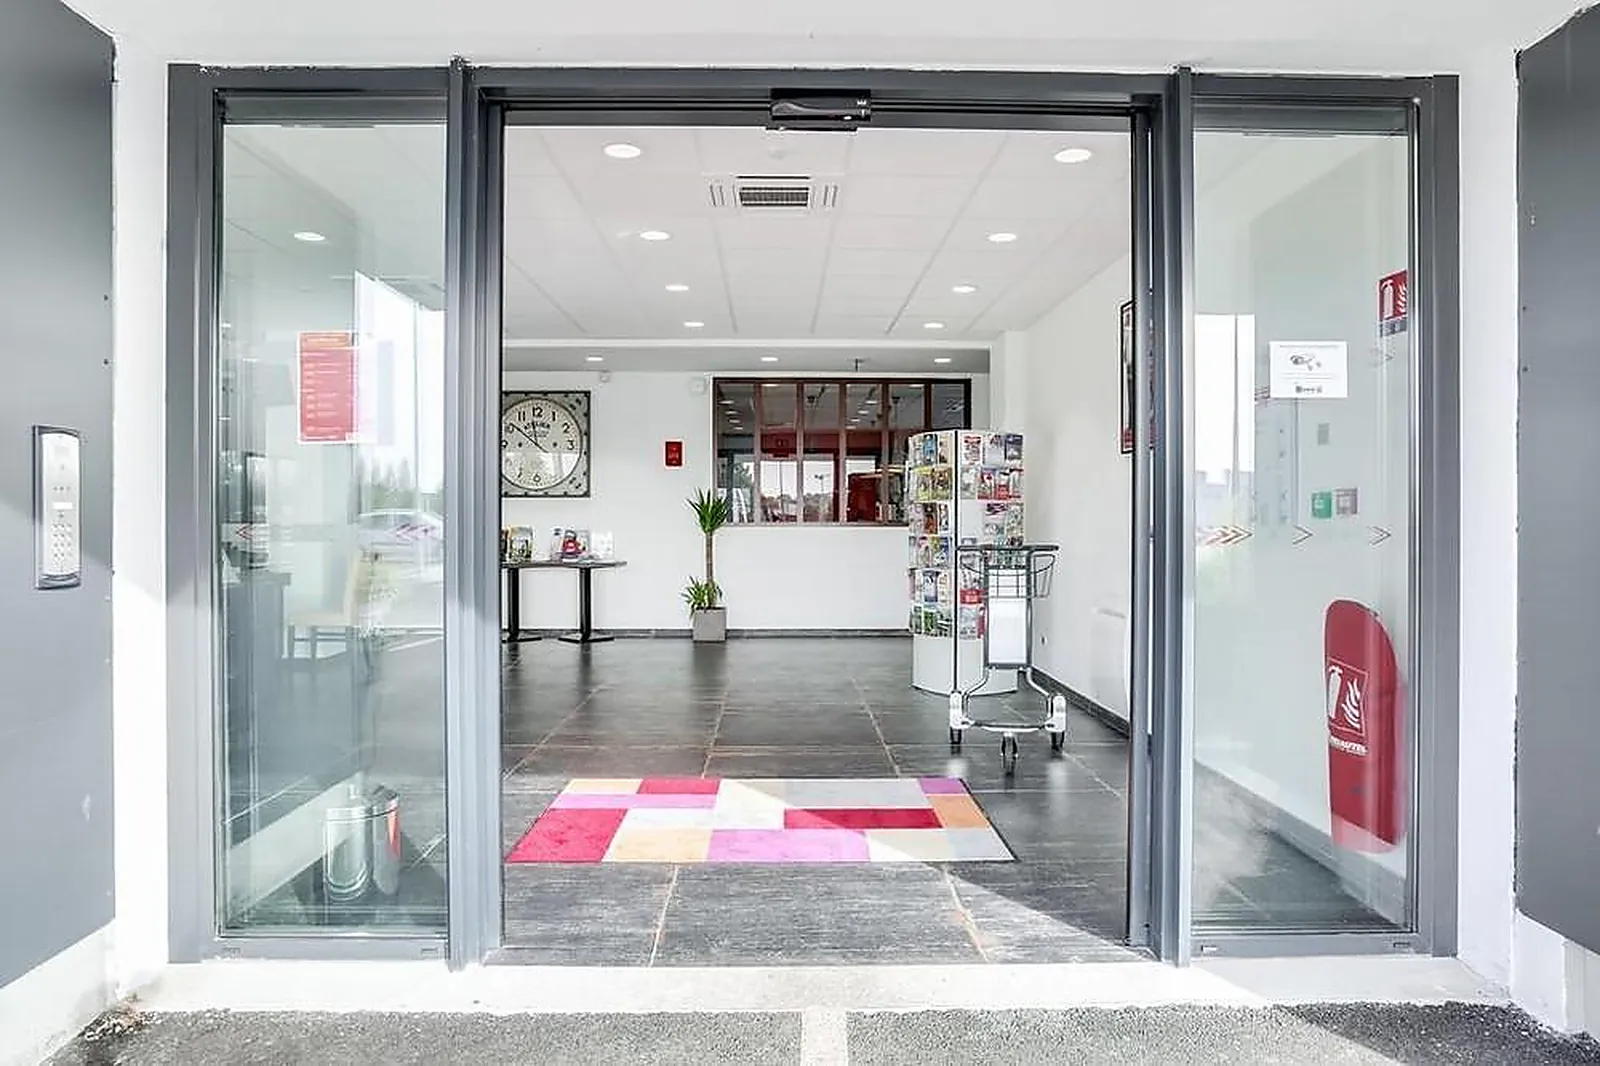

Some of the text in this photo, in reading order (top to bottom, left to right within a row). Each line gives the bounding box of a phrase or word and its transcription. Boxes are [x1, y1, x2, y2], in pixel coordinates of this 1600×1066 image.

[518, 411, 526, 421] 11
[532, 406, 543, 418] 12
[562, 422, 570, 433] 2
[567, 440, 575, 451] 3
[533, 474, 541, 483] 6
